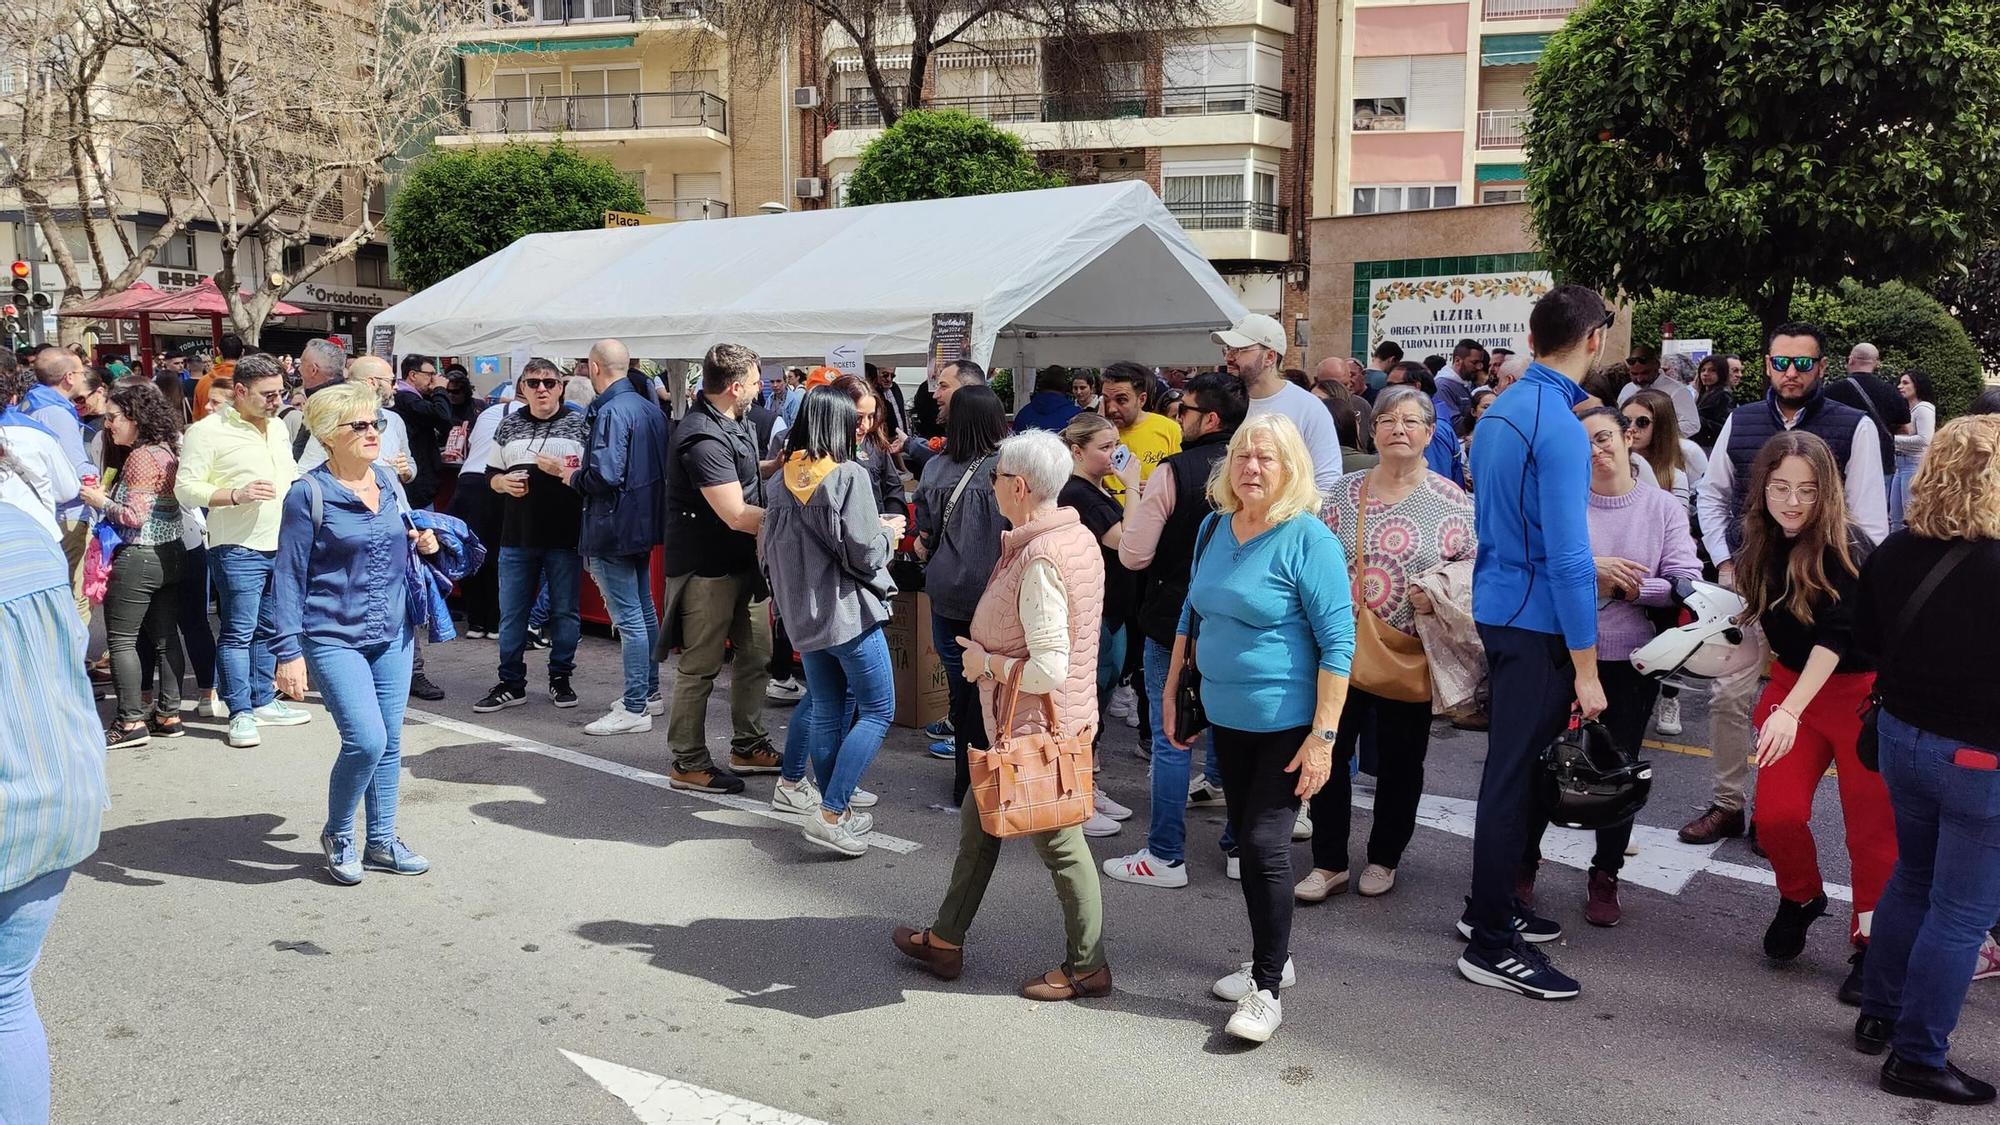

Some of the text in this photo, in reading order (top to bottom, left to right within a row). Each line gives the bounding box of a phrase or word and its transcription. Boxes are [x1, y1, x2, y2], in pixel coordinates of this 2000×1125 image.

[315, 288, 383, 307] Ortodoncia
[1430, 309, 1482, 321] ALZIRA
[1390, 325, 1421, 335] ORIGEN
[1423, 322, 1456, 334] PÀTRIA
[1464, 323, 1497, 333] LLOTJA
[1500, 323, 1511, 332] DE
[1513, 322, 1525, 332] LA
[179, 341, 196, 352] TODA
[1400, 339, 1438, 349] TARONJA
[833, 361, 856, 369] TICKETS
